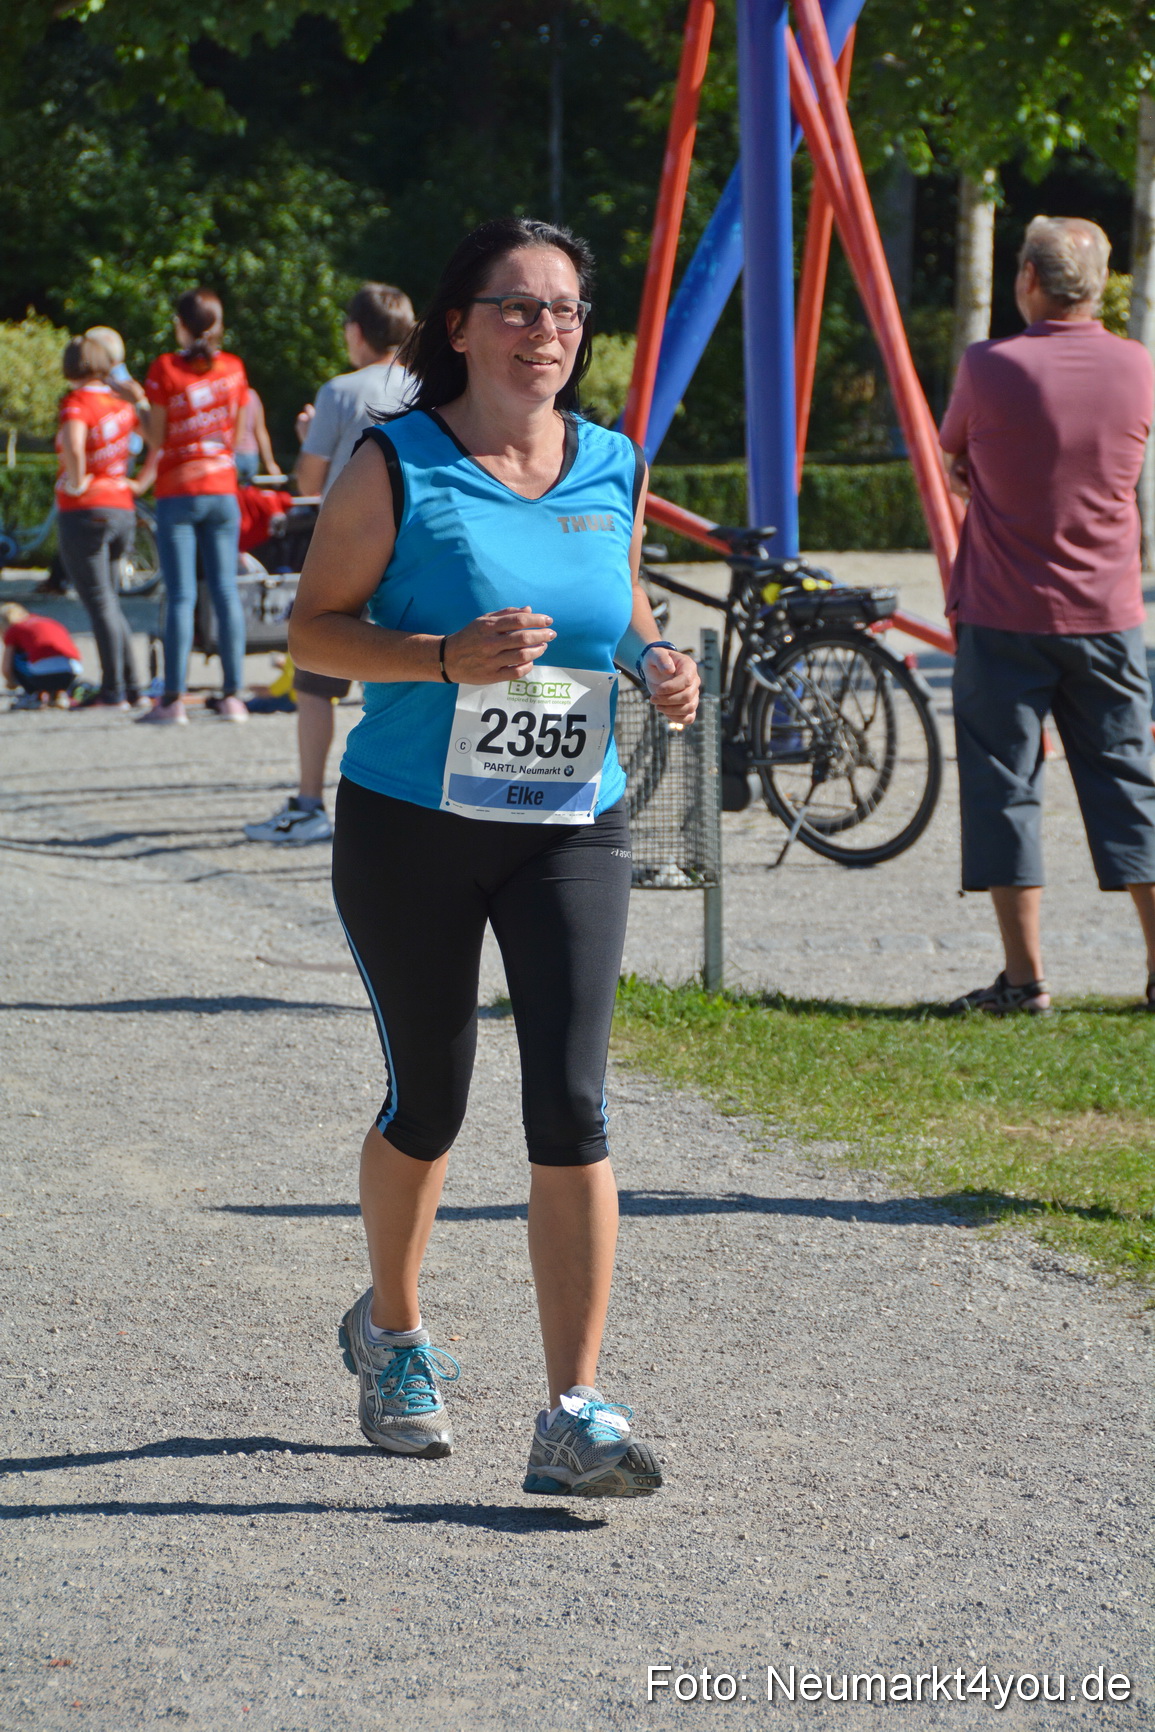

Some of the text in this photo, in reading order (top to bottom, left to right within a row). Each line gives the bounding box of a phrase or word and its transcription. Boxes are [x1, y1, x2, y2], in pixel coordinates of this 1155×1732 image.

[557, 514, 616, 533] THULE
[508, 680, 572, 698] BOCK
[476, 708, 587, 758] 2355
[460, 741, 467, 750] C
[483, 761, 561, 775] PARTL Neumarkt
[506, 785, 544, 806] Elke
